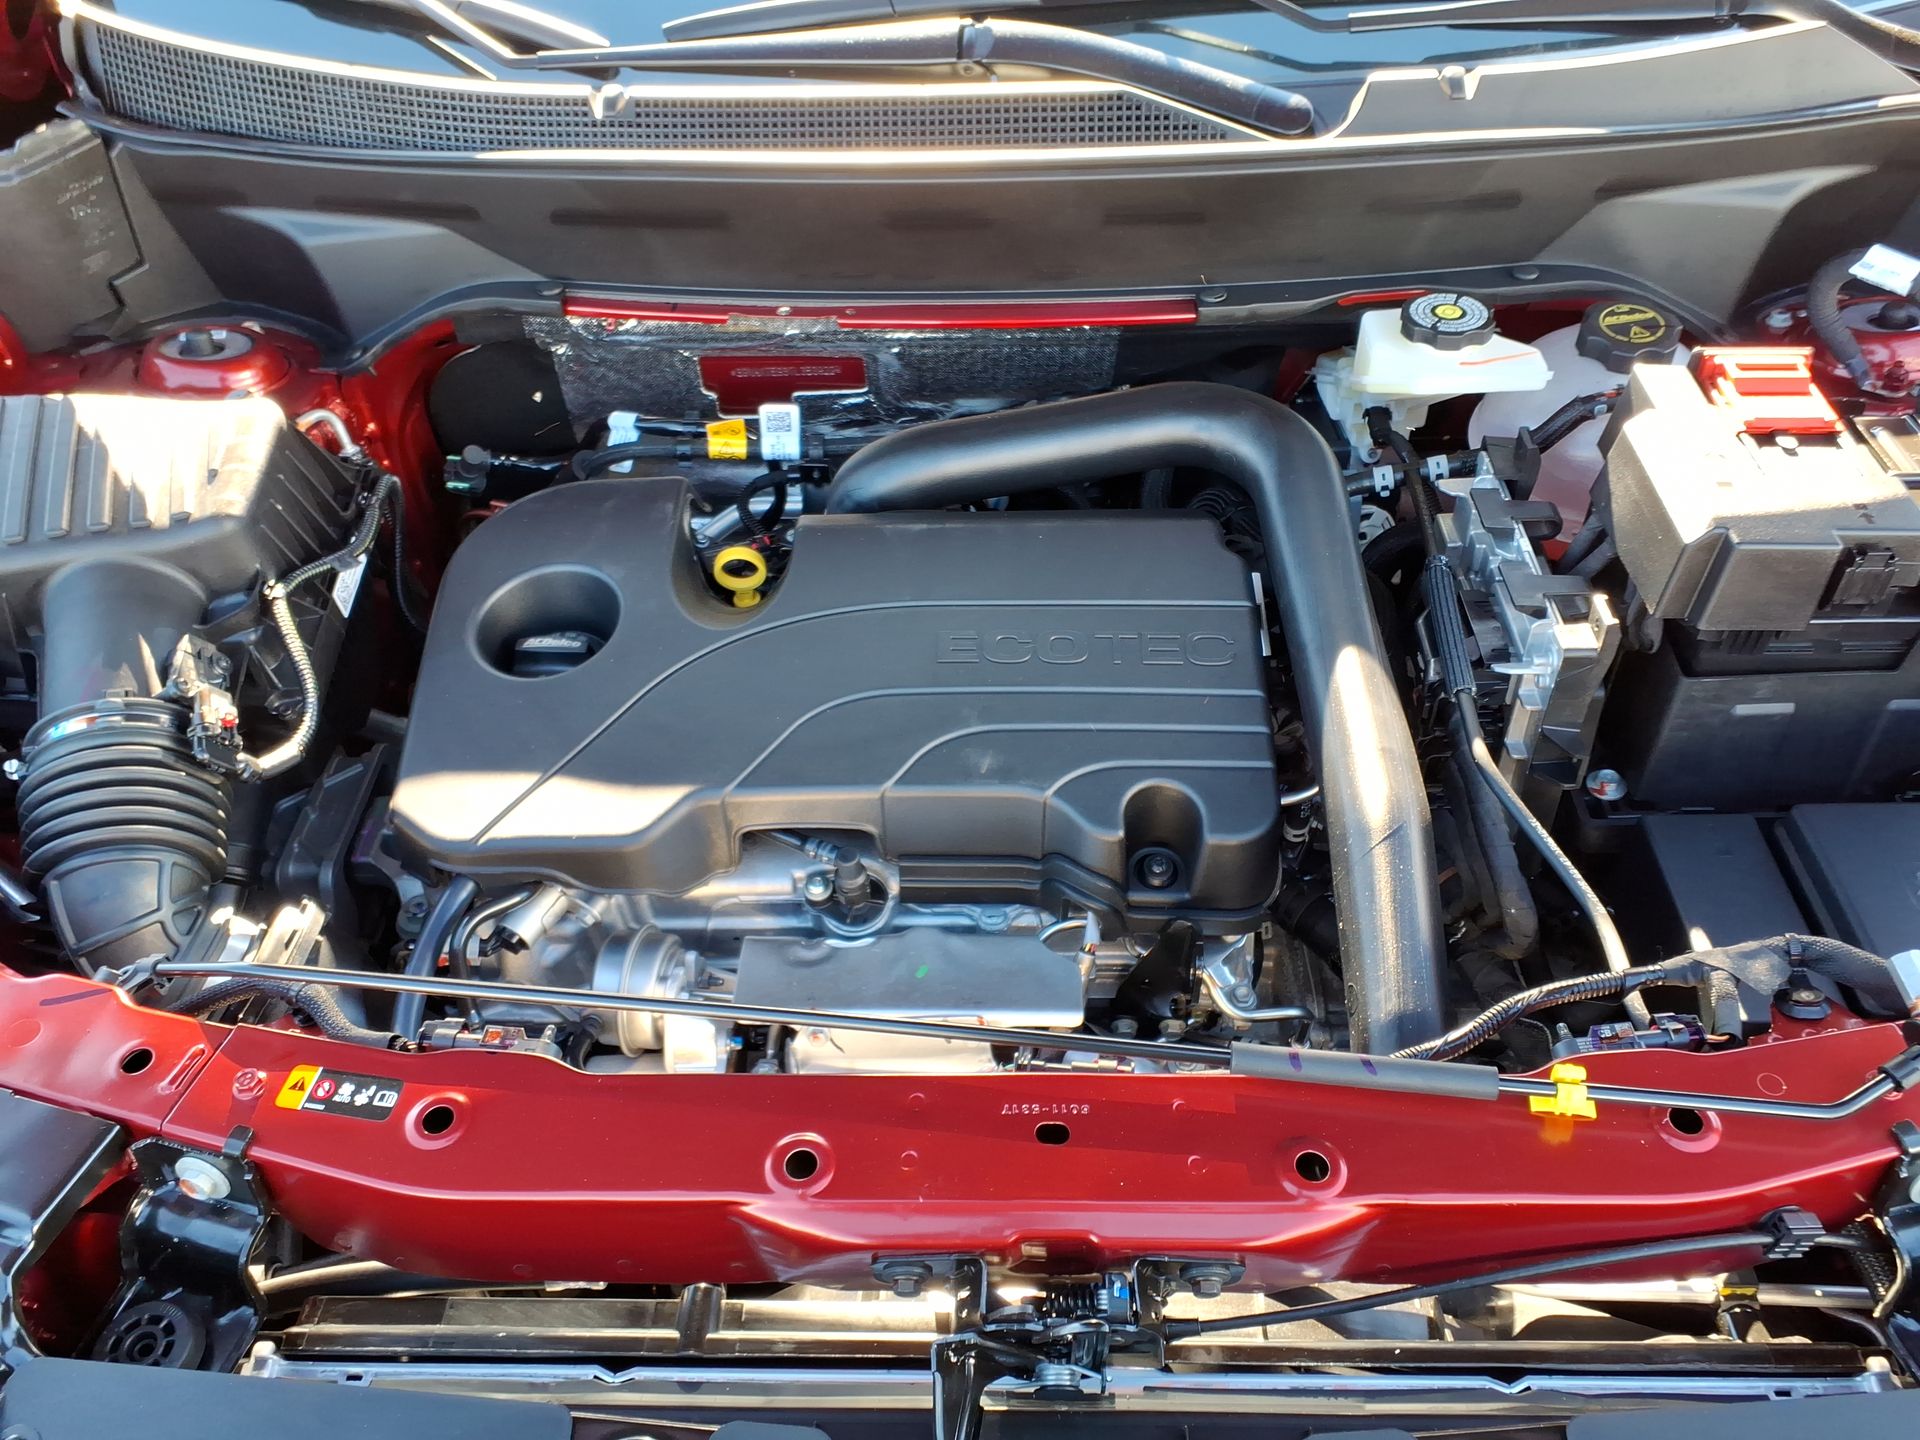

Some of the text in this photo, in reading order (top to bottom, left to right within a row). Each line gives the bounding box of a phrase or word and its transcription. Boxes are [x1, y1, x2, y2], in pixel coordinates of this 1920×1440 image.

[522, 637, 582, 648] ACDelco
[936, 631, 1234, 666] ECOTEC
[332, 1094, 351, 1103] AUTO
